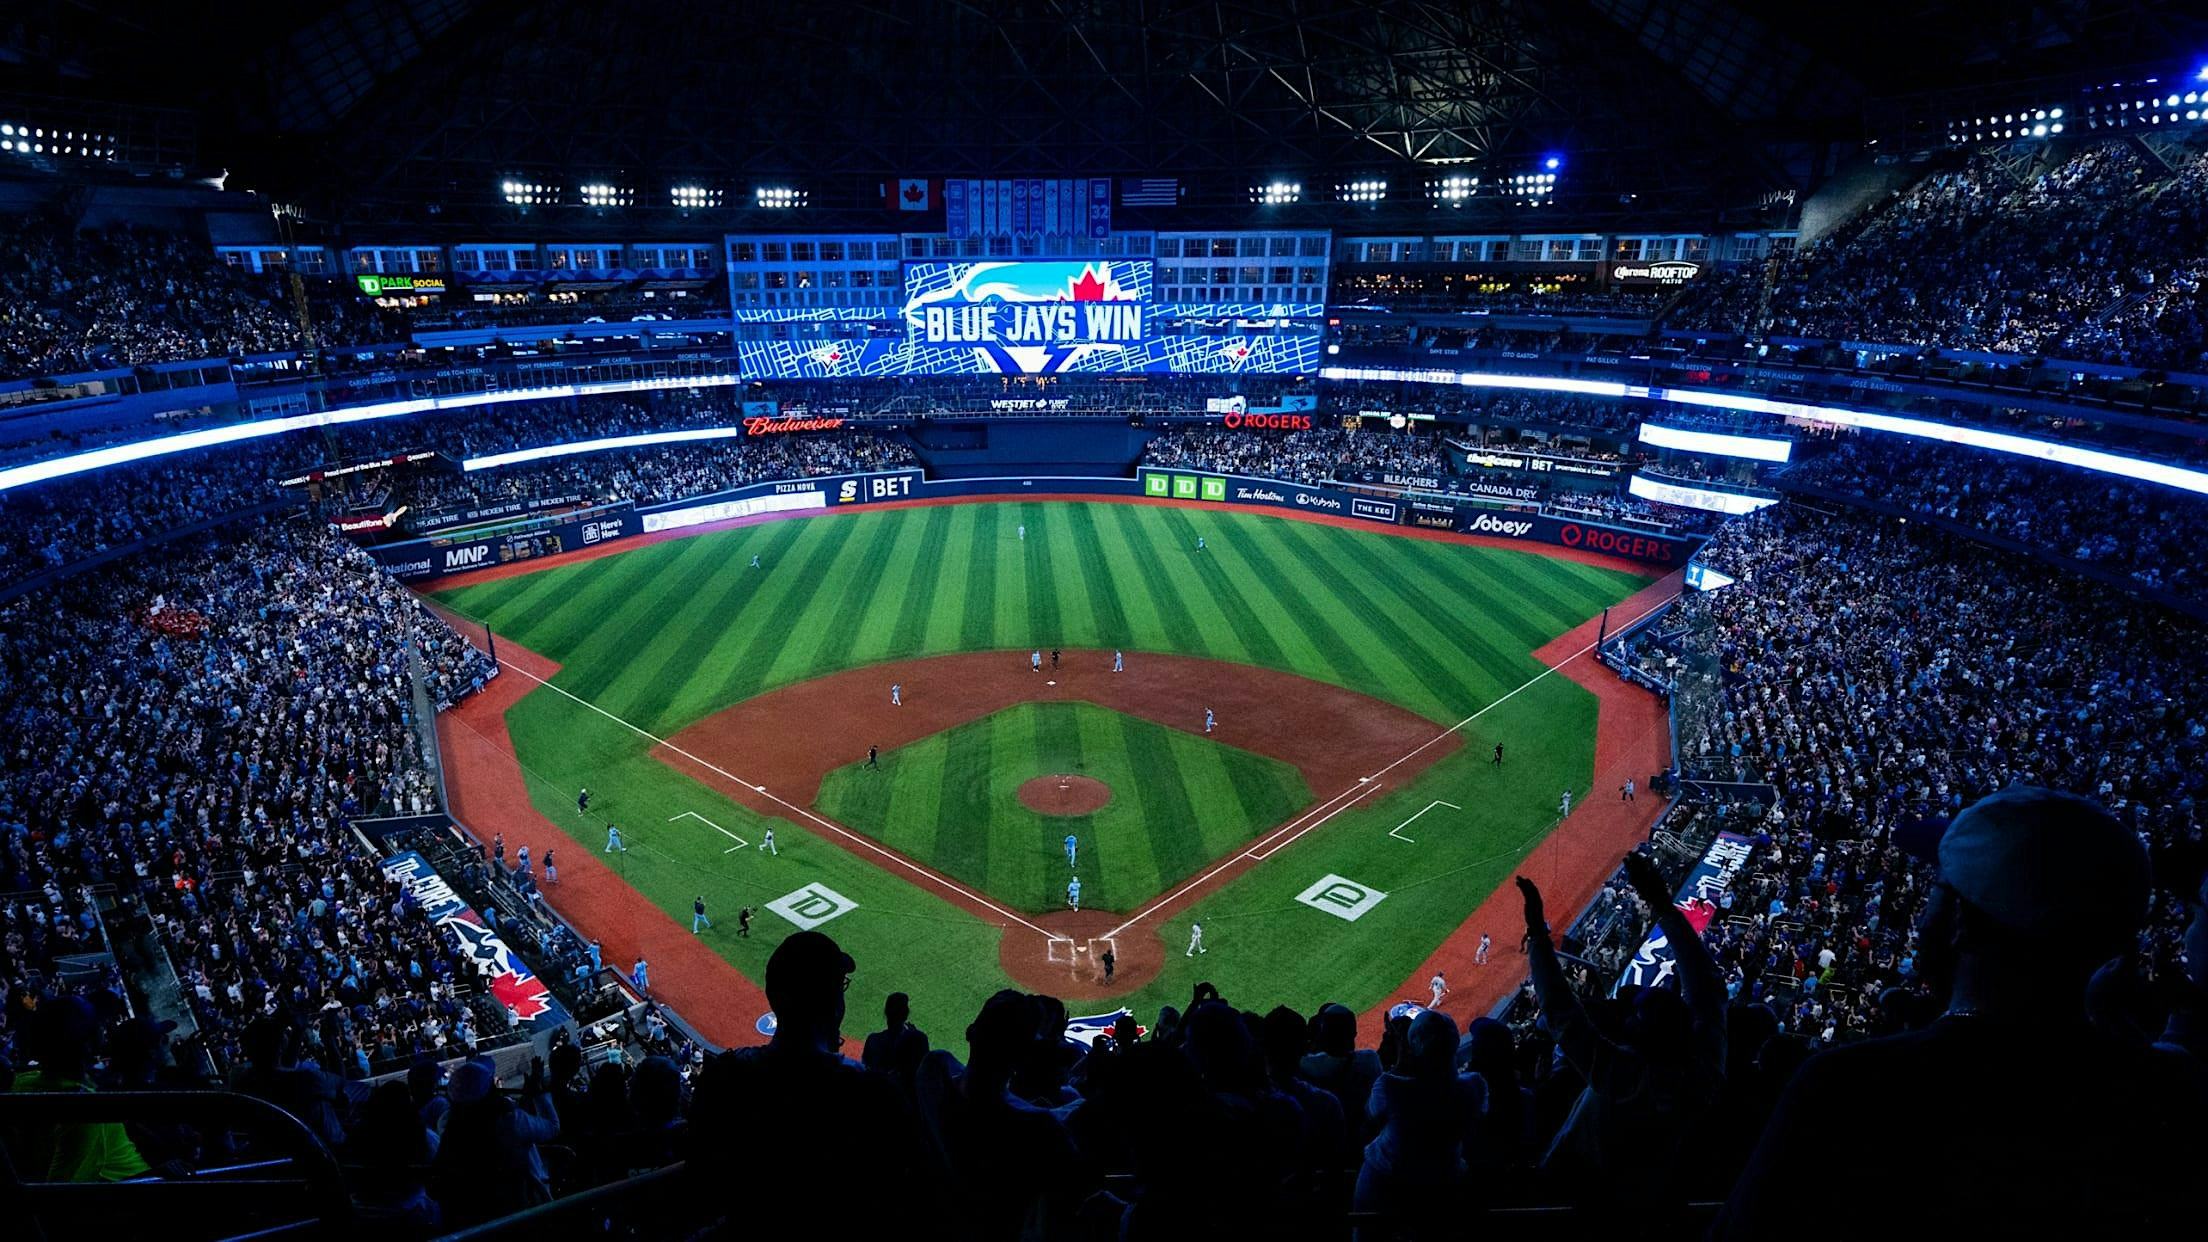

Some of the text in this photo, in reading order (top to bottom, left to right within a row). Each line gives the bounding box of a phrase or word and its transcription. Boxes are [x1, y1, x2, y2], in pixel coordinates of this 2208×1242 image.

[1091, 205, 1109, 219] 32
[1614, 266, 1698, 280] Corona ROOFTOP
[359, 277, 445, 292] TD PARK SOCIAL
[926, 304, 1143, 343] BLUE JAYS WIN
[991, 399, 1035, 410] WESTJET
[742, 416, 844, 436] Budweiser
[1244, 414, 1312, 430] ROGERS
[1531, 460, 1553, 471] BET
[776, 482, 816, 494] PIZZA NOVA
[873, 476, 913, 497] BET
[1383, 474, 1438, 488] BLEACHERS
[1237, 487, 1285, 502] Tim Hortons
[1469, 483, 1513, 496] CANADA
[1515, 488, 1537, 500] DRY
[540, 494, 581, 507] NEXEN TIRE
[1310, 495, 1341, 509] Kubota
[480, 503, 521, 517] NEXEN TIRE
[1357, 504, 1391, 515] THE KEG
[442, 514, 459, 523] TIRE
[600, 518, 623, 530] Here's
[1469, 514, 1533, 537] Sobeys
[1585, 529, 1673, 562] ROGERS
[446, 545, 489, 568] MNP
[1310, 882, 1367, 909] TD
[787, 889, 840, 920] TD
